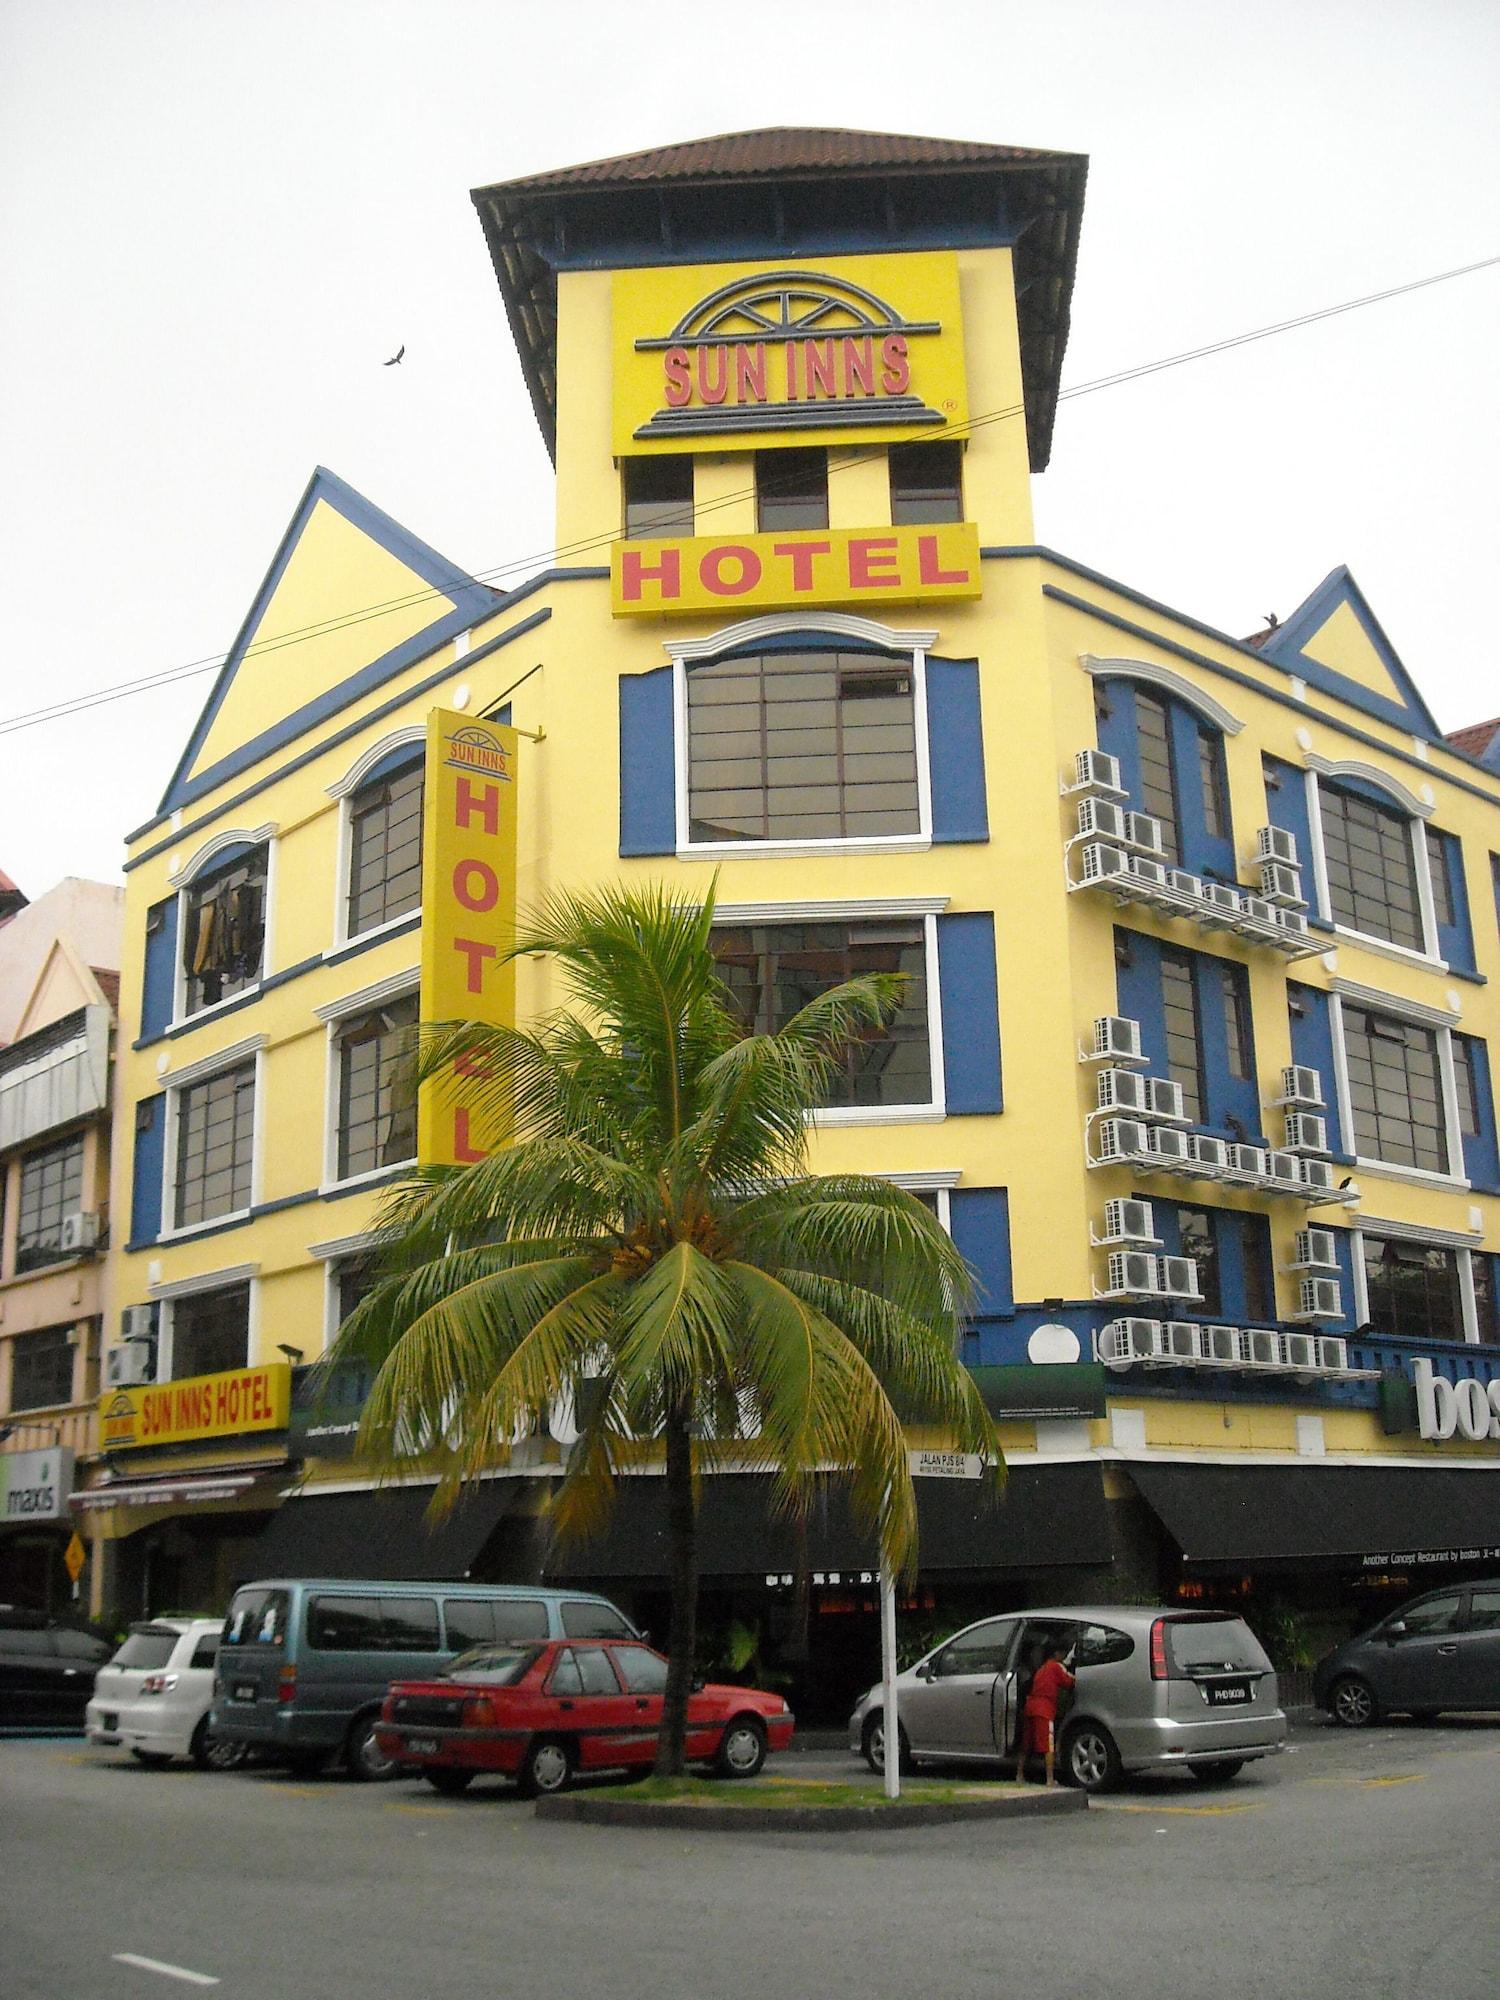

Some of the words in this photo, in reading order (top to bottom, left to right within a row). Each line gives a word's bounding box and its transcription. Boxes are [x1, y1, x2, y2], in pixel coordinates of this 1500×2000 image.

[663, 342, 766, 406] SUN
[786, 332, 910, 402] INNS
[622, 535, 969, 600] HOTEL
[450, 743, 475, 763] SUN
[478, 749, 506, 771] INNS
[143, 1390, 172, 1437] SUN
[176, 1383, 213, 1431] INNS
[217, 1374, 273, 1425] HOTEL
[920, 1453, 941, 1465] JALAN
[942, 1455, 954, 1466] PJS
[8, 1486, 54, 1514] maxis
[1362, 1554, 1389, 1565] Another
[1391, 1553, 1416, 1566] Concept
[1418, 1551, 1449, 1563] Restaurant
[1450, 1551, 1459, 1562] by
[1460, 1549, 1481, 1560] boston
